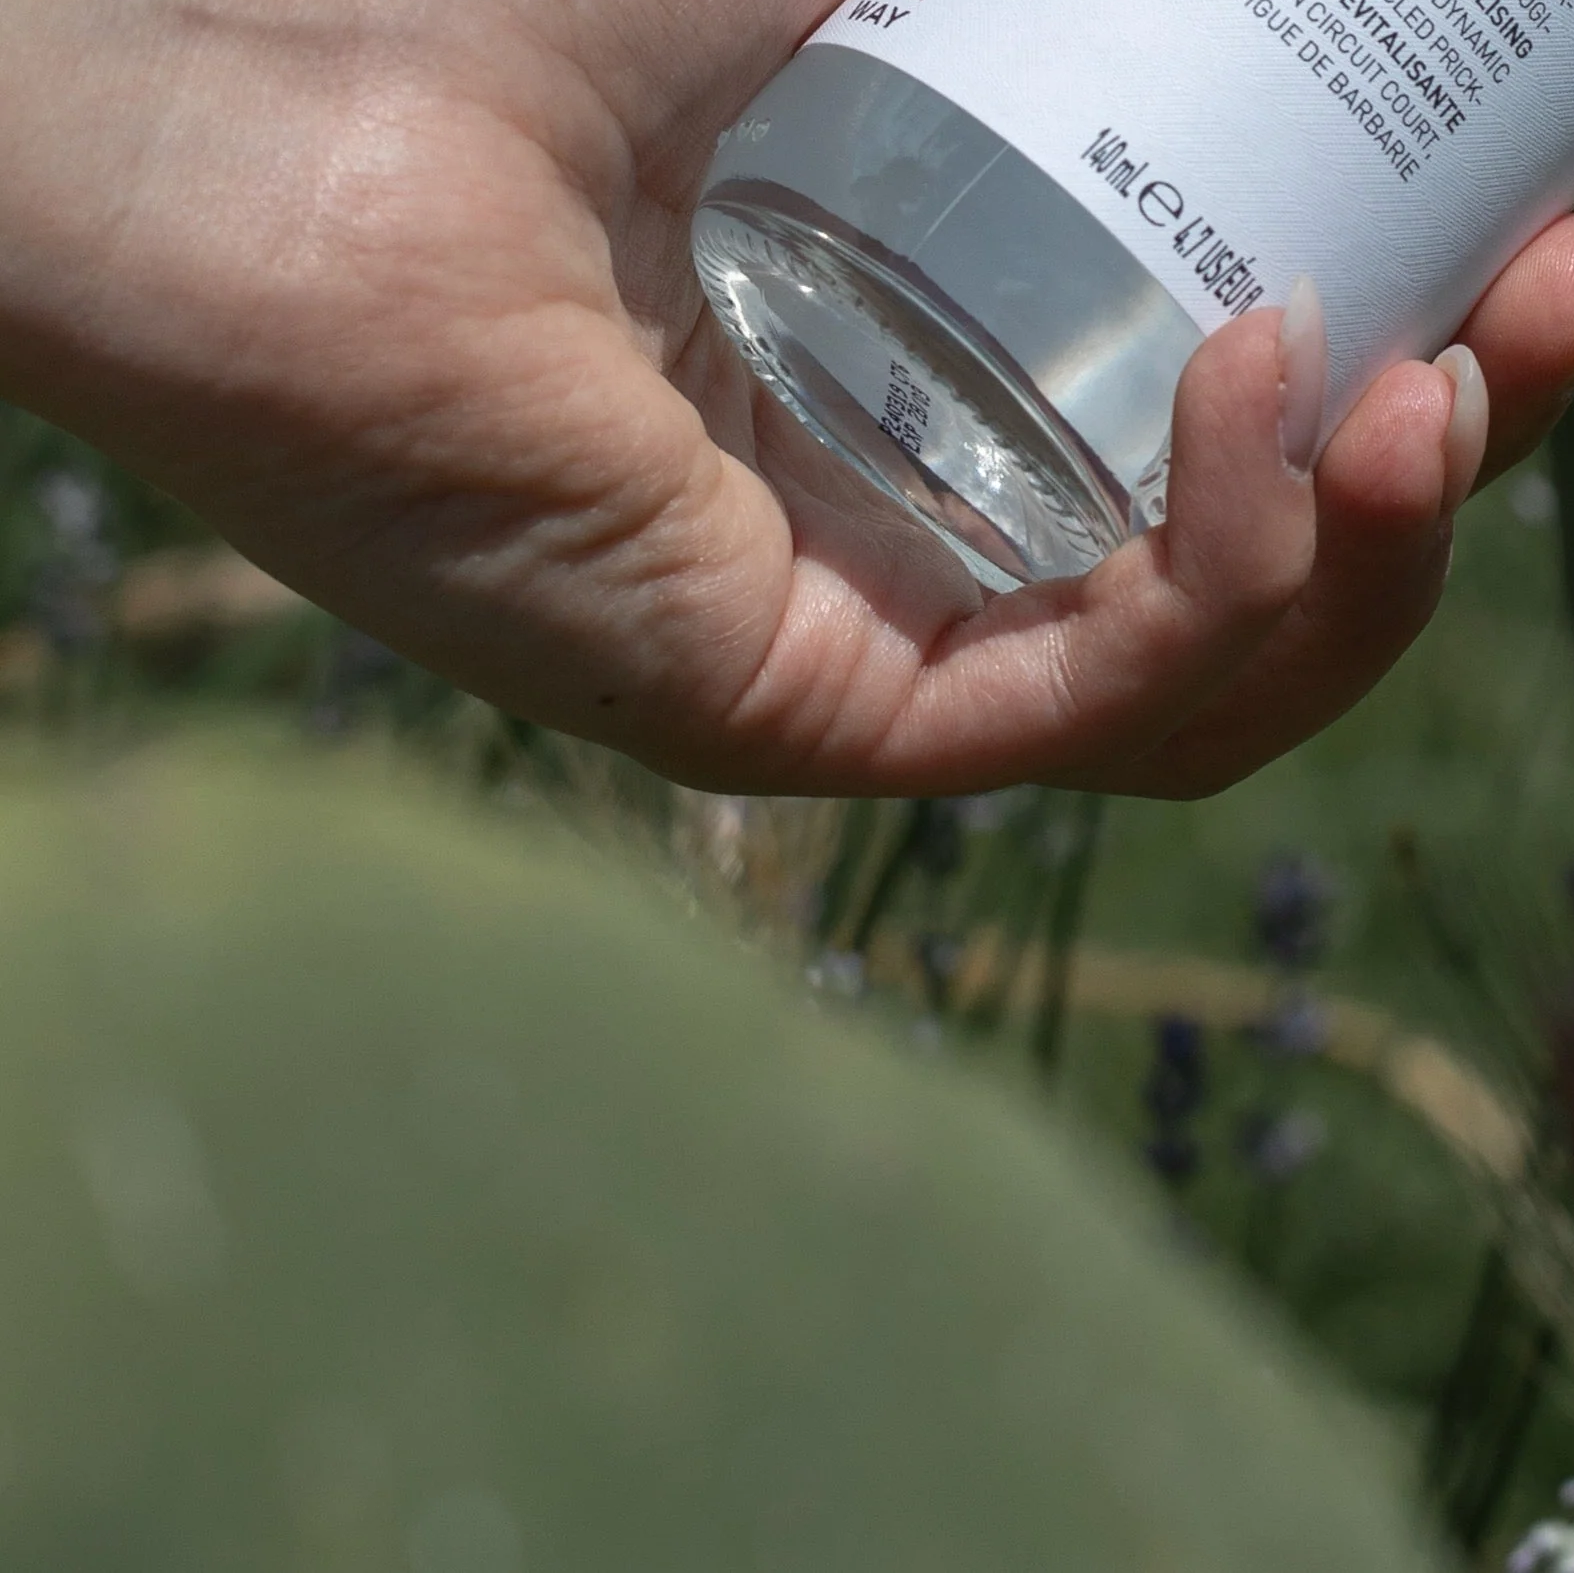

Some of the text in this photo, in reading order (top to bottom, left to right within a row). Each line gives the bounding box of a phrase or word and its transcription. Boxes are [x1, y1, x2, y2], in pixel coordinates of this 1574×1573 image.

[848, 0, 911, 28] WAY
[1306, 2, 1388, 83] CIRCUIT
[1380, 80, 1441, 160] COURT,
[1428, 35, 1484, 106] PRICK-
[1298, 40, 1335, 78] DE
[1327, 72, 1420, 183] BARBARIE
[1173, 217, 1214, 259] 4.7
[900, 423, 923, 454] EXP
